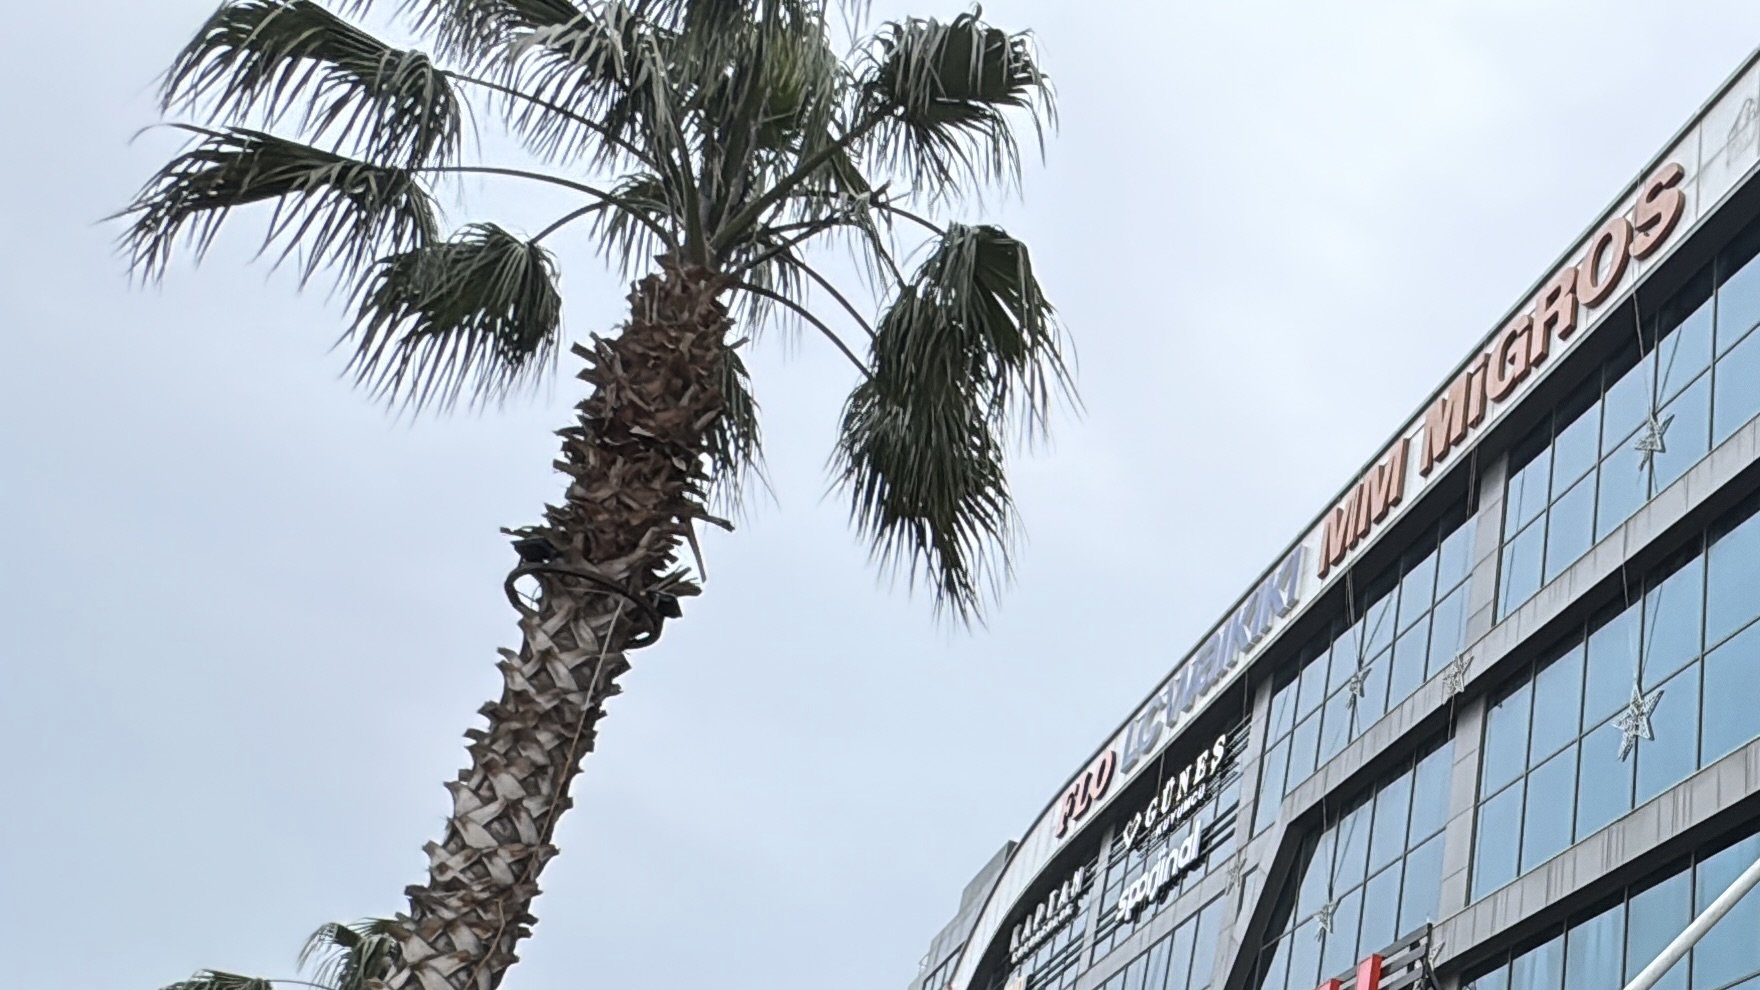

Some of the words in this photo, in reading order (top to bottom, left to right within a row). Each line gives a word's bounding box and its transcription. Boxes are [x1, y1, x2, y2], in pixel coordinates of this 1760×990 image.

[1318, 439, 1410, 579] MM
[1121, 697, 1167, 774] LC
[1162, 545, 1308, 729] WAIKIKI
[1056, 750, 1117, 839] FLO
[1156, 783, 1206, 837] KUYUMCU
[1009, 866, 1085, 953] KAPTAN
